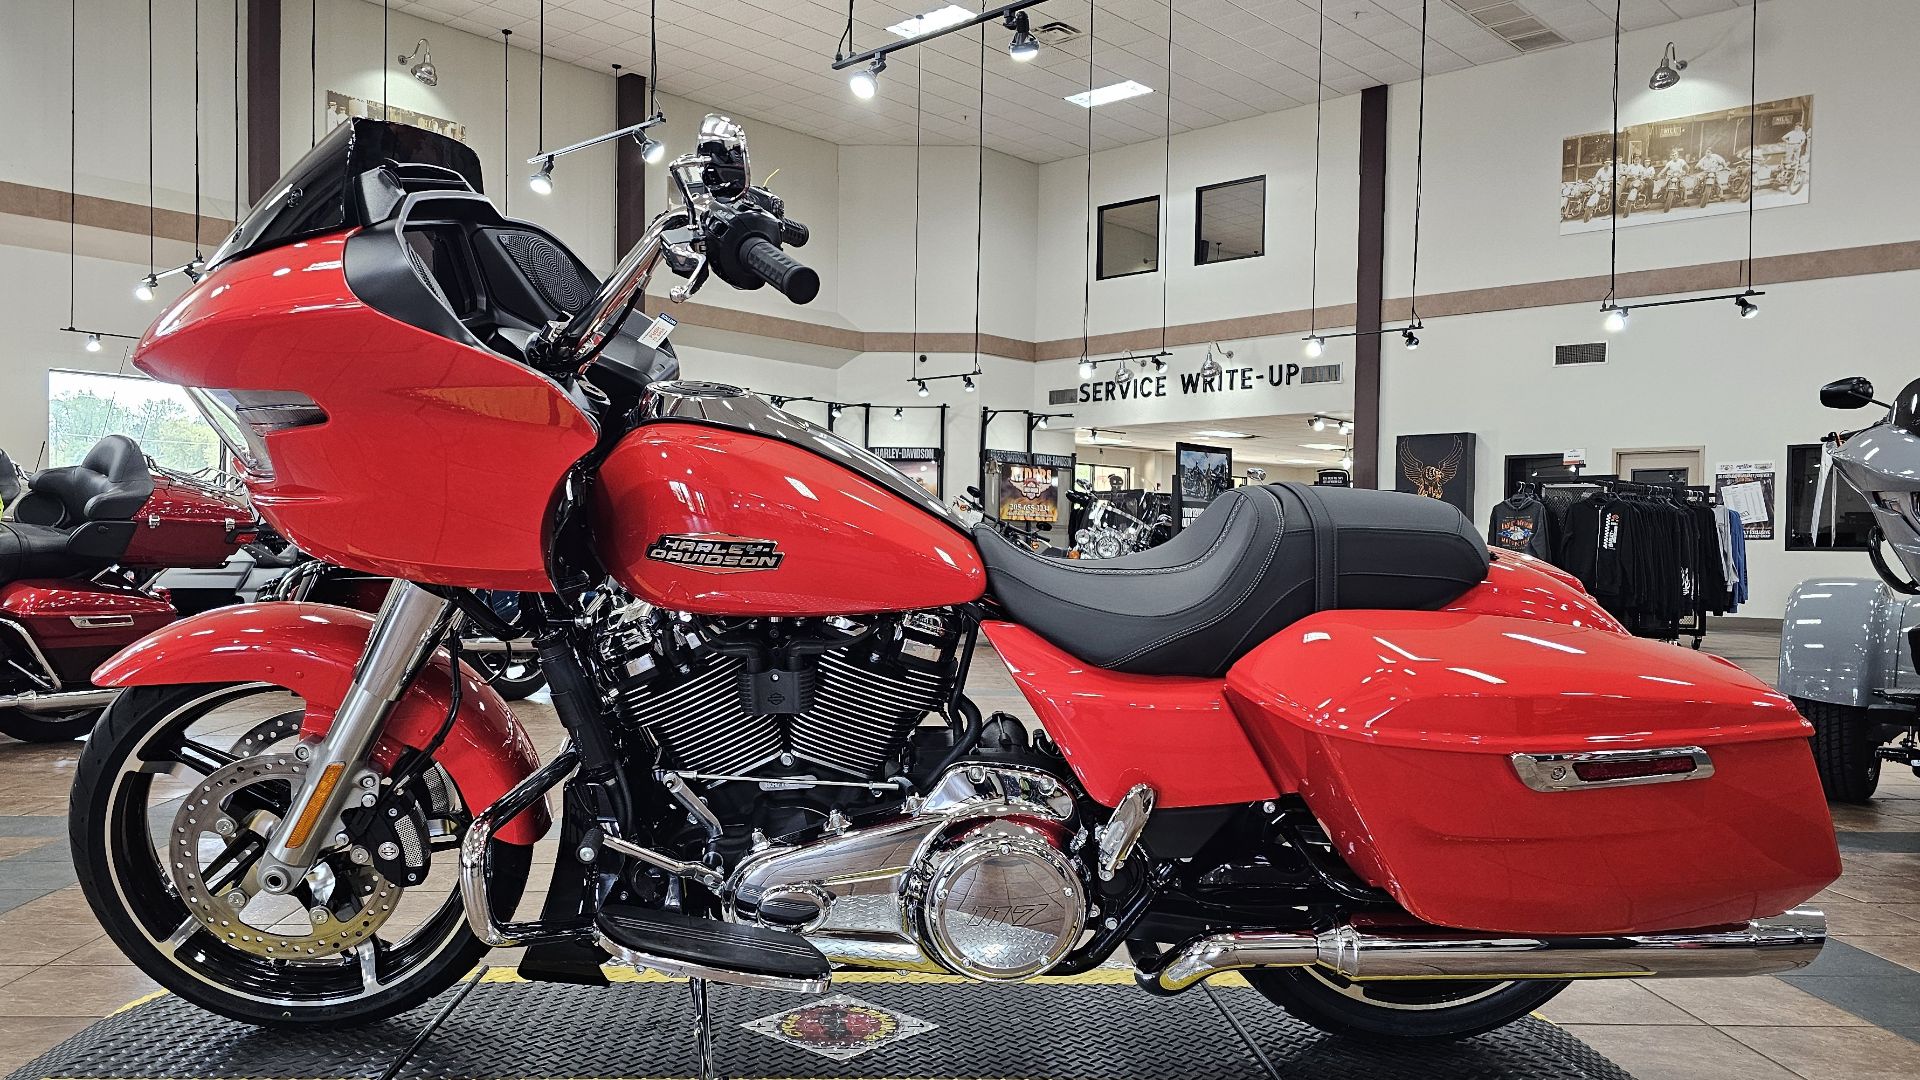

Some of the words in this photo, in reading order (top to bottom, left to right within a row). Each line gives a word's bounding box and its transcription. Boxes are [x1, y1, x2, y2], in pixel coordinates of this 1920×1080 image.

[1079, 376, 1167, 403] SERVICE
[1181, 363, 1299, 395] WRITE-UP
[875, 448, 934, 460] HARLEY-DAVIDSON
[664, 539, 770, 556] HARLEY-
[650, 549, 778, 567] DAVIDSON
[967, 903, 1049, 927] 117
